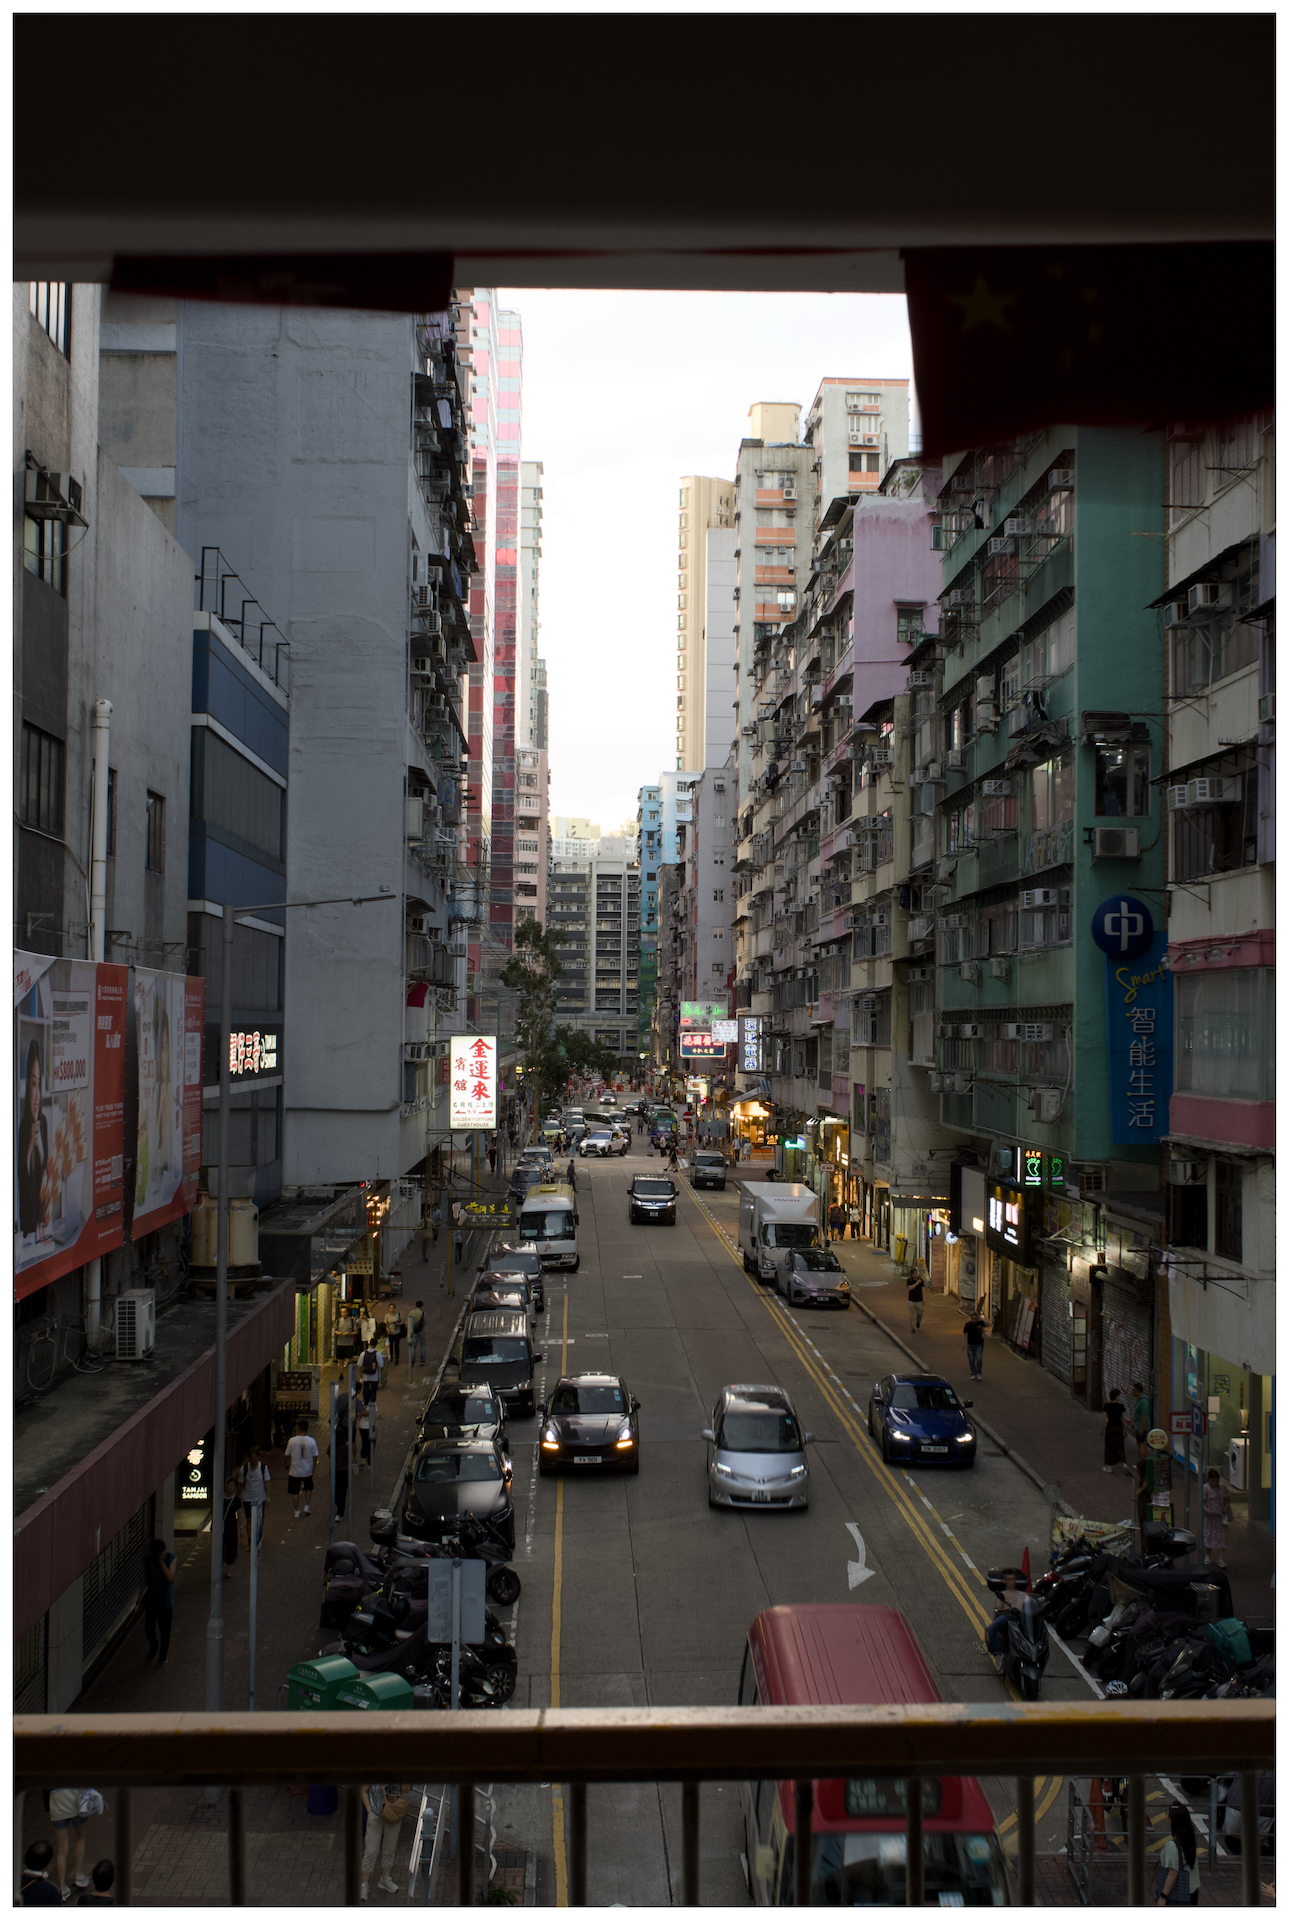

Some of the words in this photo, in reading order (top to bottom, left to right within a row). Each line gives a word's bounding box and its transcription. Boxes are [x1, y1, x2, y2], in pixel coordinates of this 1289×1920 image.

[1115, 964, 1168, 1004] Smart
[469, 1038, 494, 1101] 金運來
[744, 1018, 757, 1071] 環球電器
[1125, 1006, 1156, 1128] 智能生活
[1193, 1407, 1200, 1433] P
